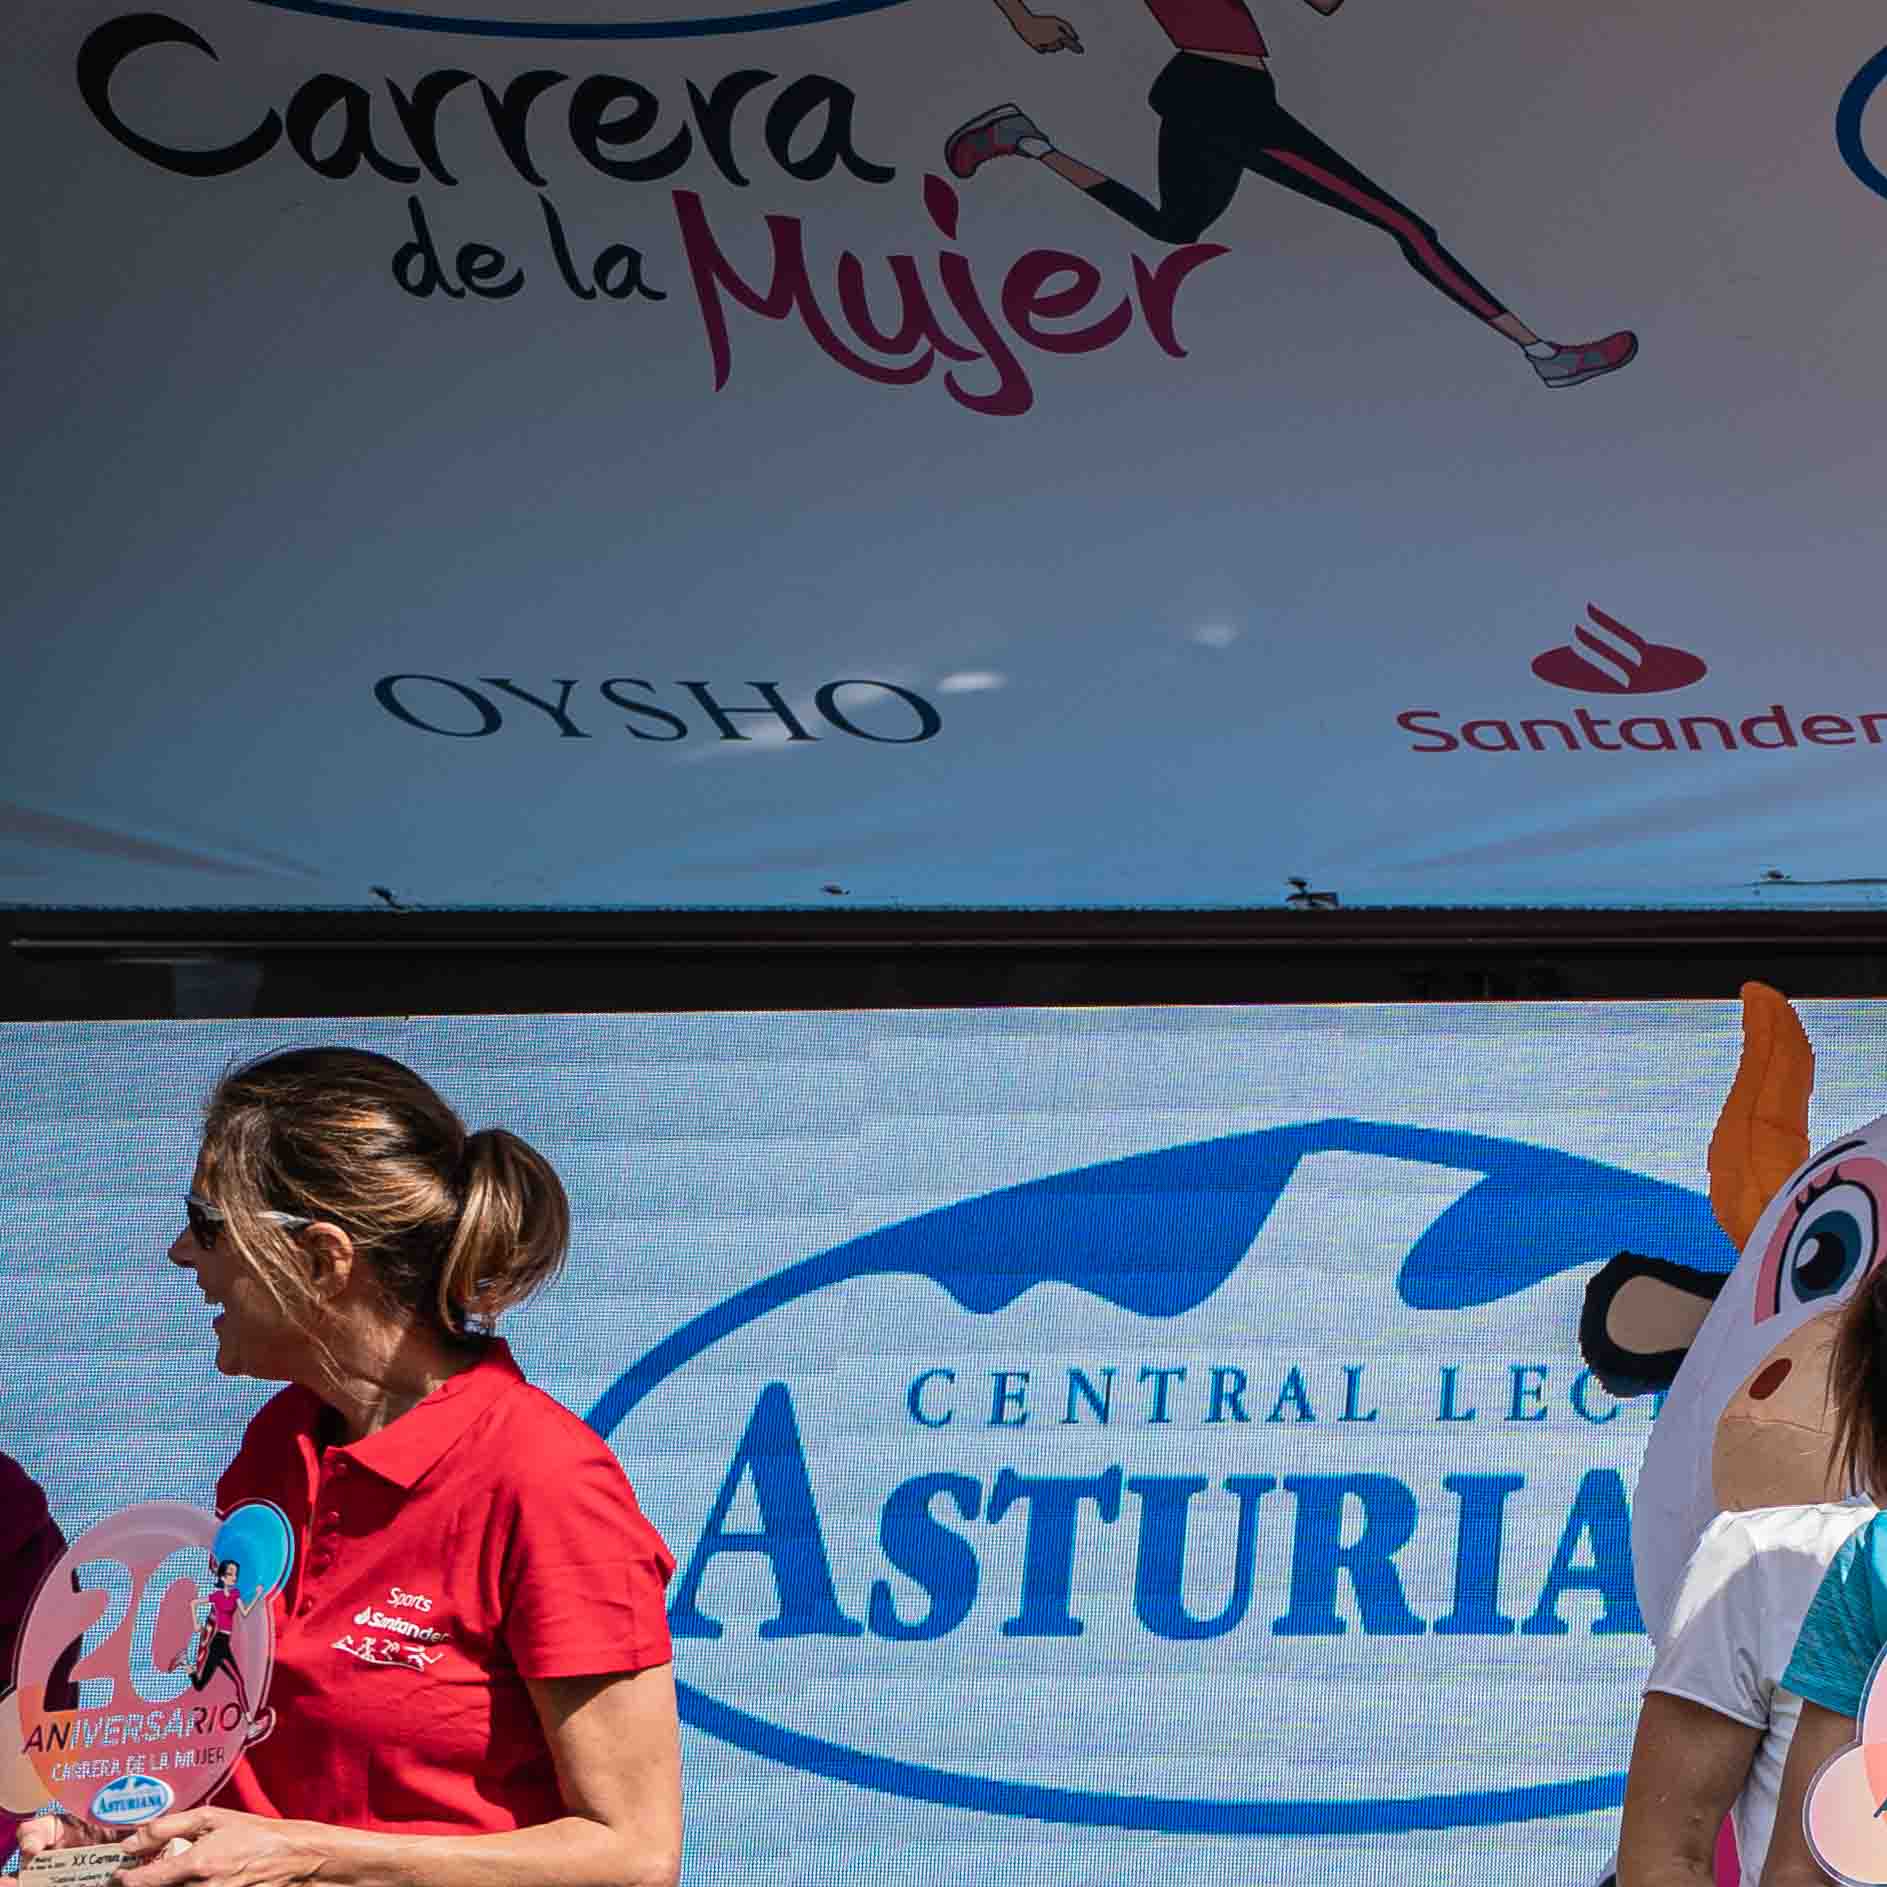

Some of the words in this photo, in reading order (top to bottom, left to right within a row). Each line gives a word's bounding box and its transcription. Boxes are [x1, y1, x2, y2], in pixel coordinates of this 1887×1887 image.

[76, 12, 895, 186] Carrera
[392, 195, 524, 300] de
[538, 193, 667, 302] la
[671, 172, 1232, 416] Mujer
[372, 673, 944, 745] OYSHO
[906, 1365, 1380, 1428] CENTRAL
[665, 1380, 1648, 1641] ASTURIA
[44, 1546, 216, 1713] 20
[367, 1611, 450, 1643] Santander
[387, 1586, 432, 1612] Sports
[23, 1702, 242, 1754] ANIVERSARIO
[51, 1759, 121, 1781] CARRERA
[126, 1755, 145, 1776] DE
[151, 1751, 169, 1771] LA
[175, 1747, 225, 1769] MUJER
